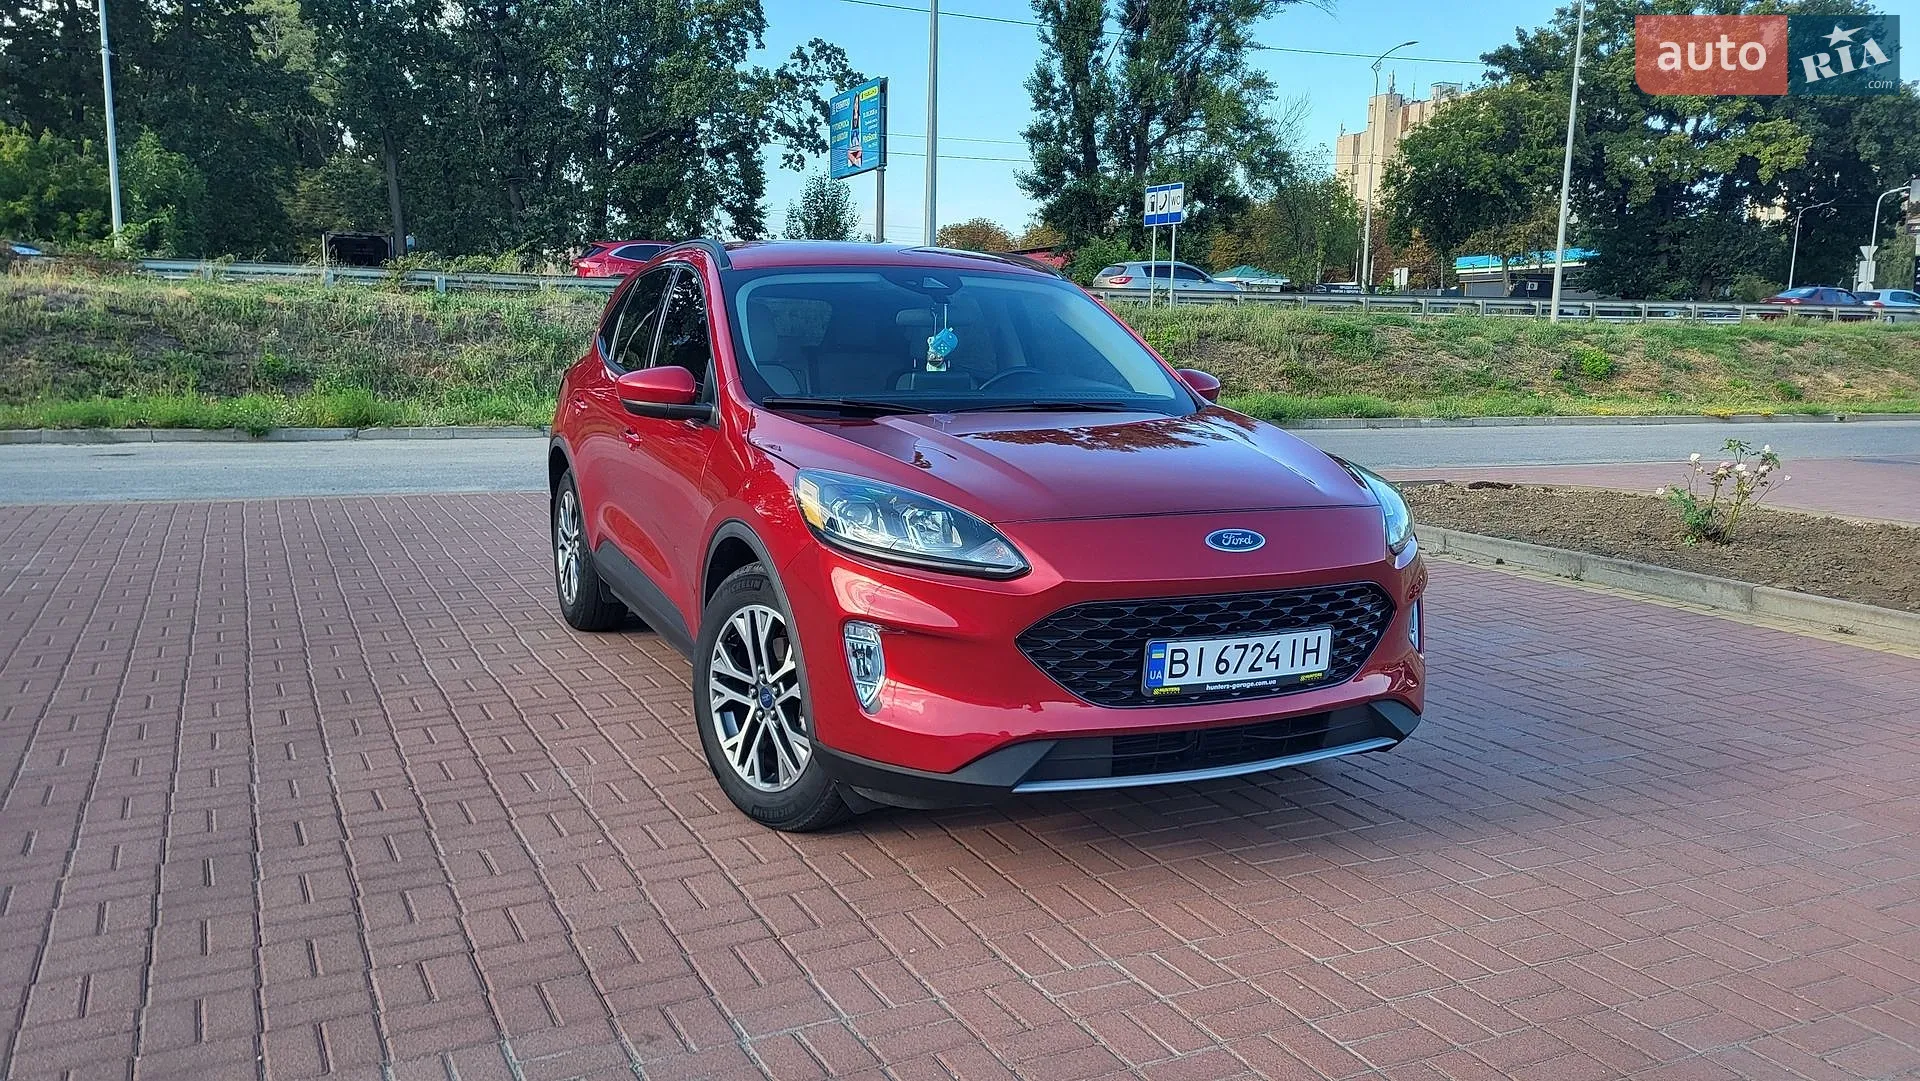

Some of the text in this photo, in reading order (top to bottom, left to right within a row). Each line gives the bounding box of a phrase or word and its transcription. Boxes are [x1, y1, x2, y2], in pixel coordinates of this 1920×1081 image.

[1170, 195, 1181, 206] WC
[1222, 532, 1254, 546] Ford
[1168, 636, 1322, 679] BI 6724 IH
[1150, 670, 1163, 680] UA
[1206, 679, 1277, 691] hunters-garage.com.ua
